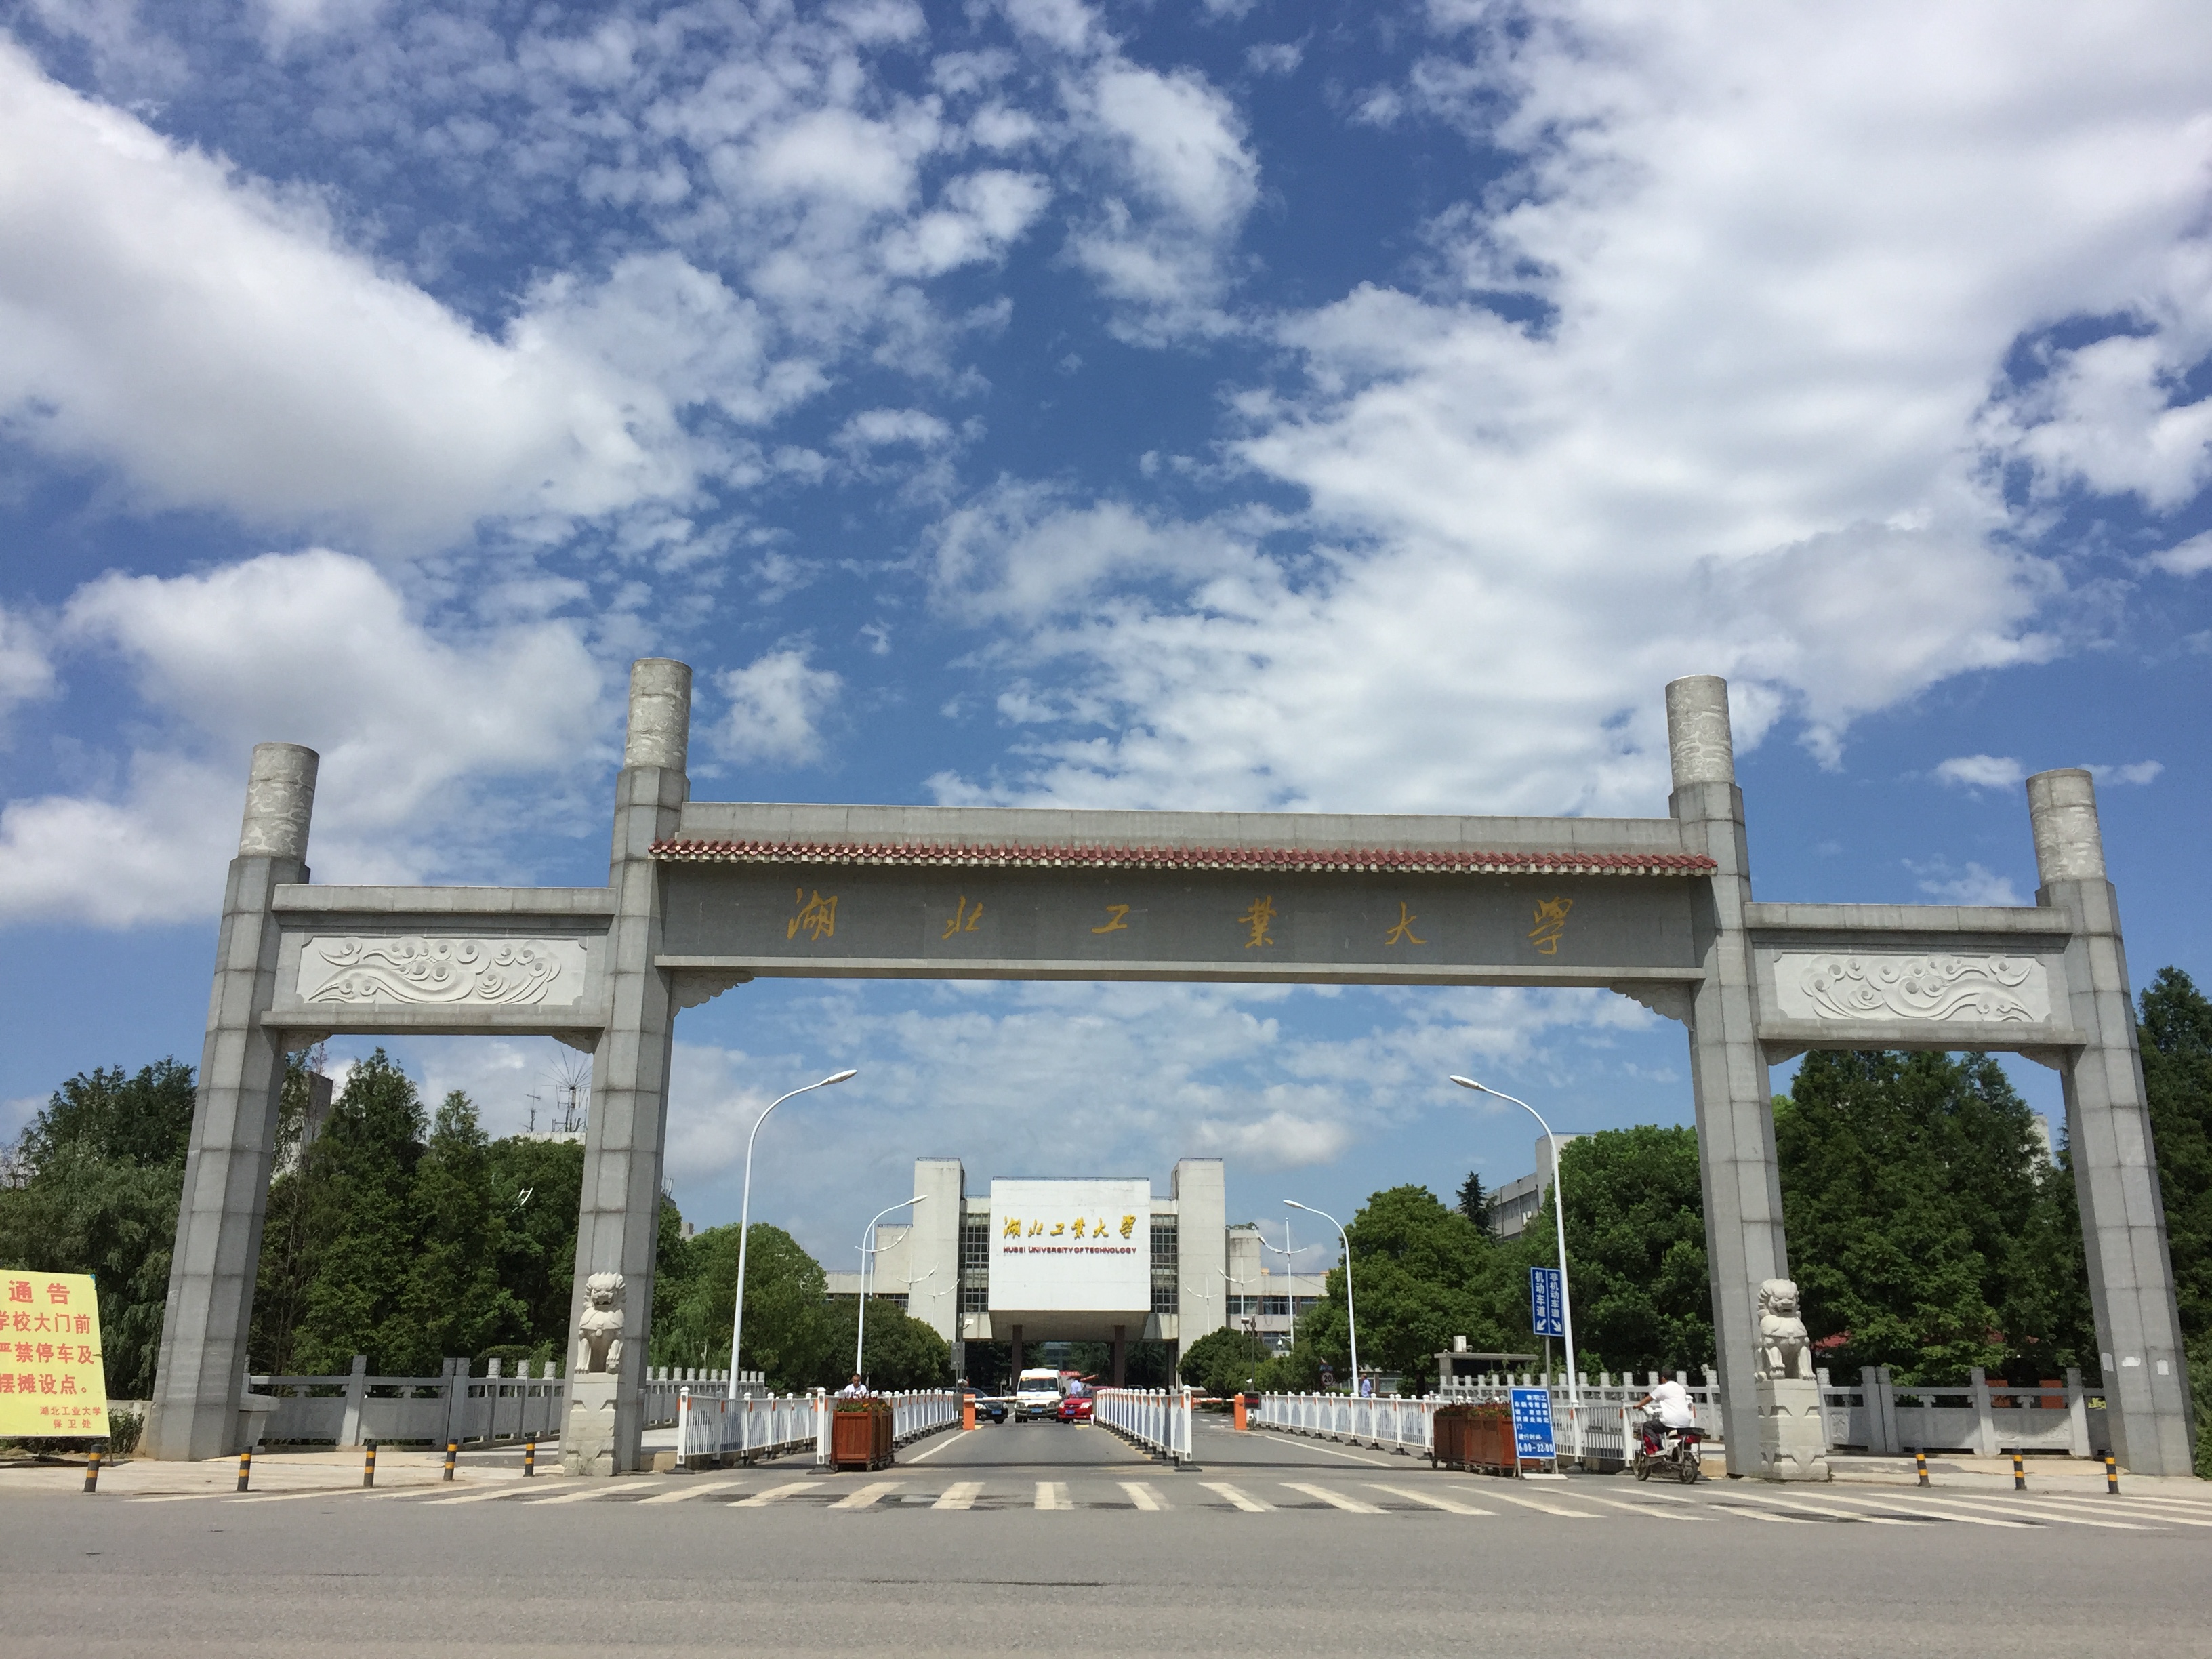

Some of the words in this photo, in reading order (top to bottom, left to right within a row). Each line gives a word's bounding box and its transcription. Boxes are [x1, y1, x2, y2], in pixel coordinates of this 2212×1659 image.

[8, 1279, 70, 1305] 通告
[1535, 1271, 1546, 1317] 机动车道
[1549, 1272, 1560, 1318] 非机动车道
[0, 1310, 91, 1334] 学校大门前
[1324, 1375, 1332, 1383] 20
[39, 1406, 102, 1416] 湖北工业大学
[53, 1419, 92, 1429] 保卫处
